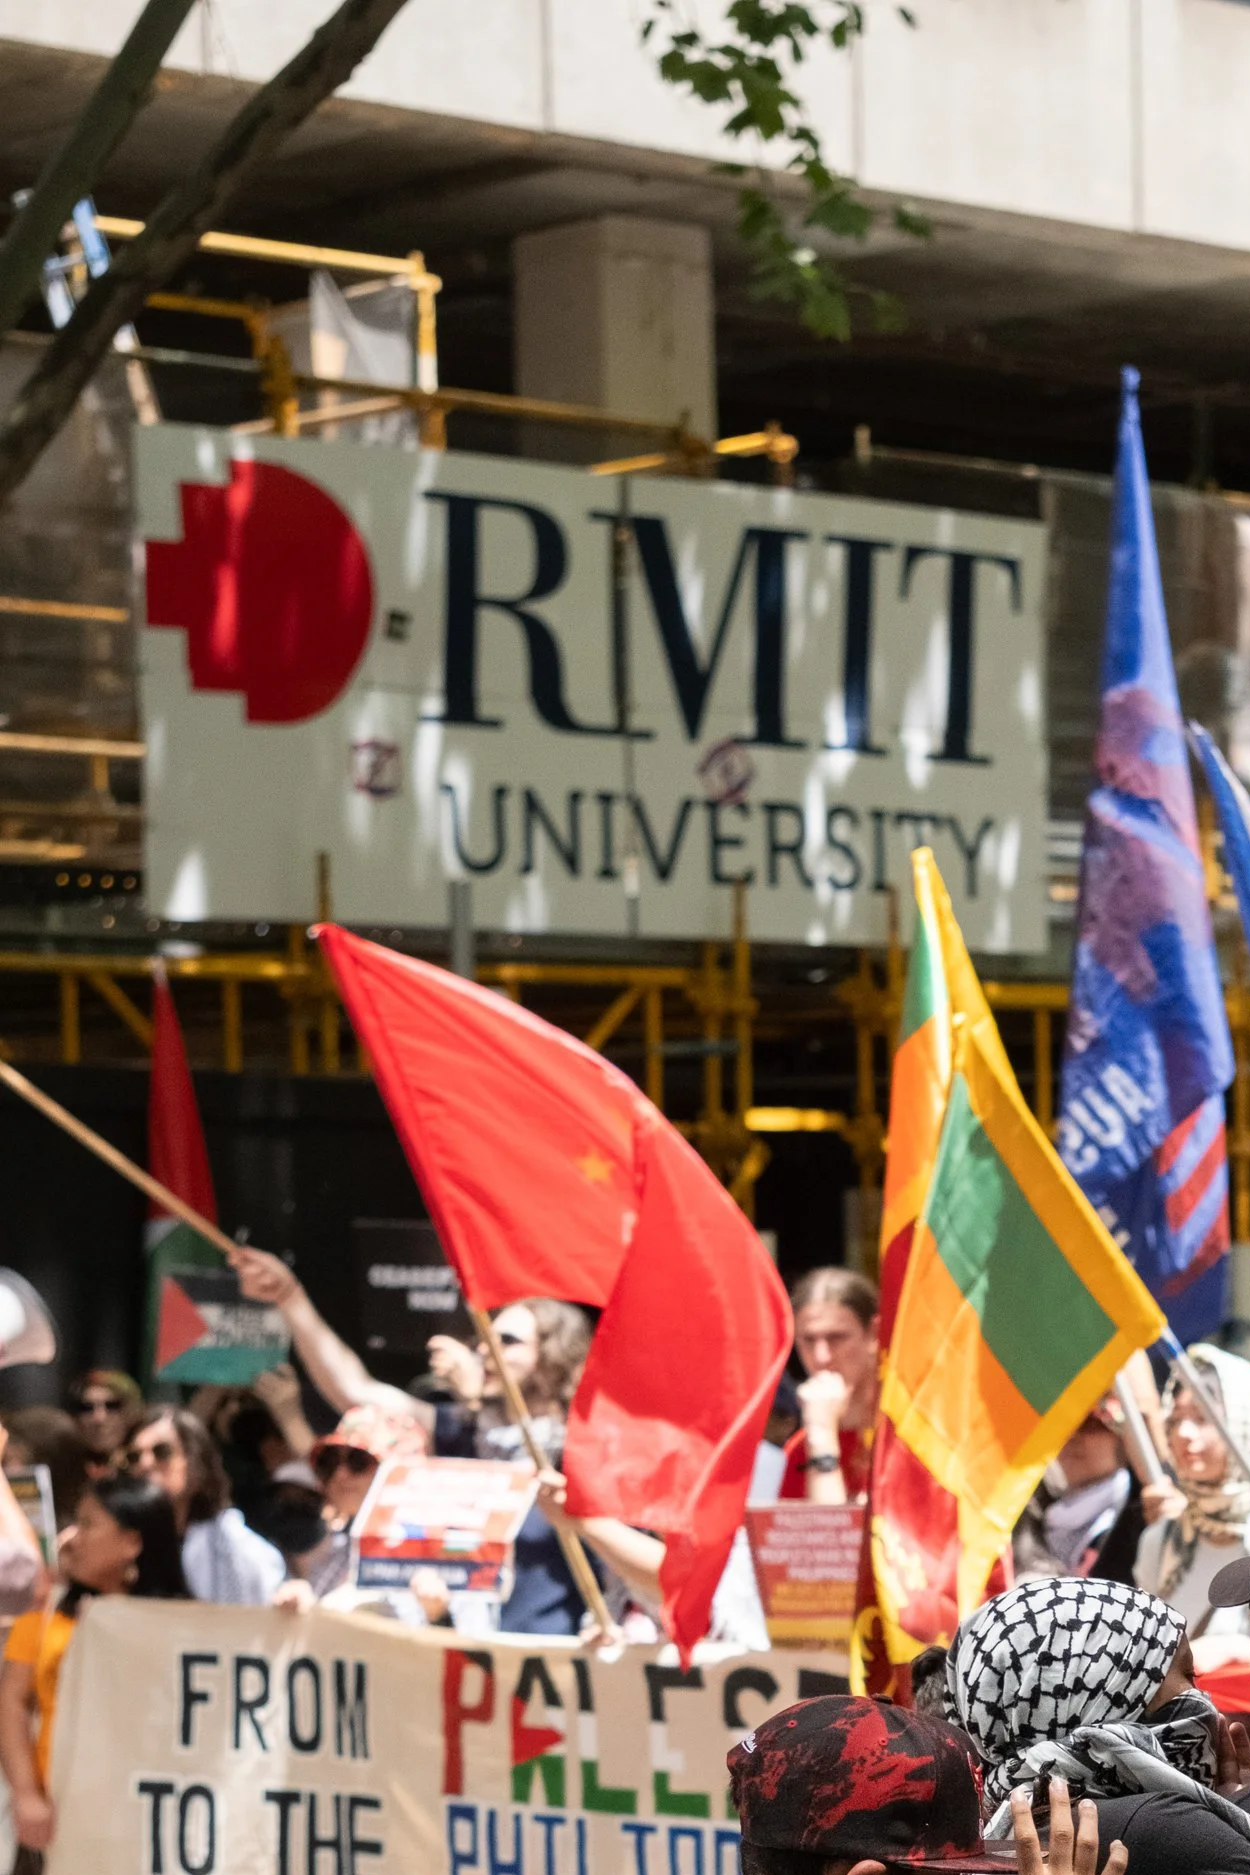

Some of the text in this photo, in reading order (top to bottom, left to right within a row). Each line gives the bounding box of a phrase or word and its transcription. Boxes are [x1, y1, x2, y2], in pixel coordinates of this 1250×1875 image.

[419, 489, 1022, 765] RMIT
[438, 782, 995, 898] UNIVERSITY
[177, 1652, 370, 1761] FROM
